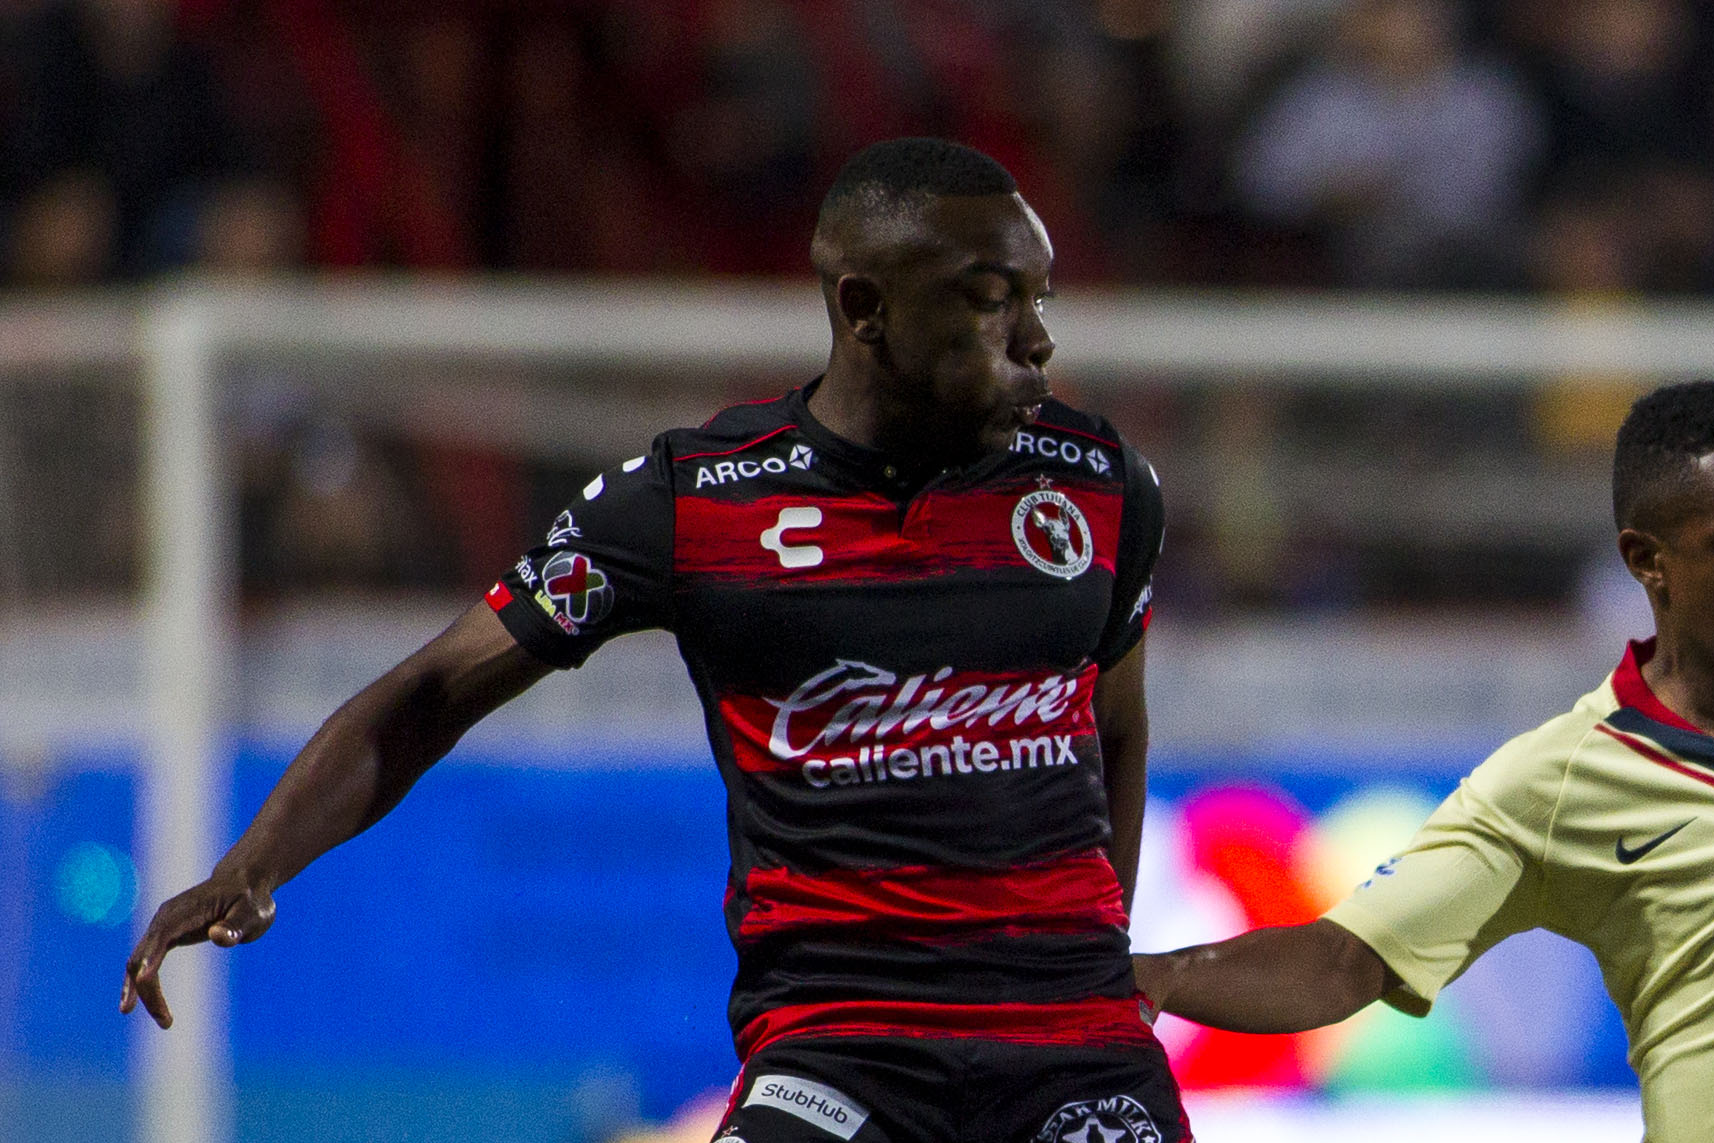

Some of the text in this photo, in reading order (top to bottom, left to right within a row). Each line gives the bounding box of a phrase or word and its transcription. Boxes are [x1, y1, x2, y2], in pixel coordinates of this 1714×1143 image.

[1008, 431, 1081, 463] RCO
[696, 457, 786, 489] ARCO
[1017, 493, 1081, 521] CLUB TIJUANA
[761, 658, 1078, 760] Caliente
[802, 733, 1079, 788] caliente.mx
[761, 1083, 848, 1124] StubHub
